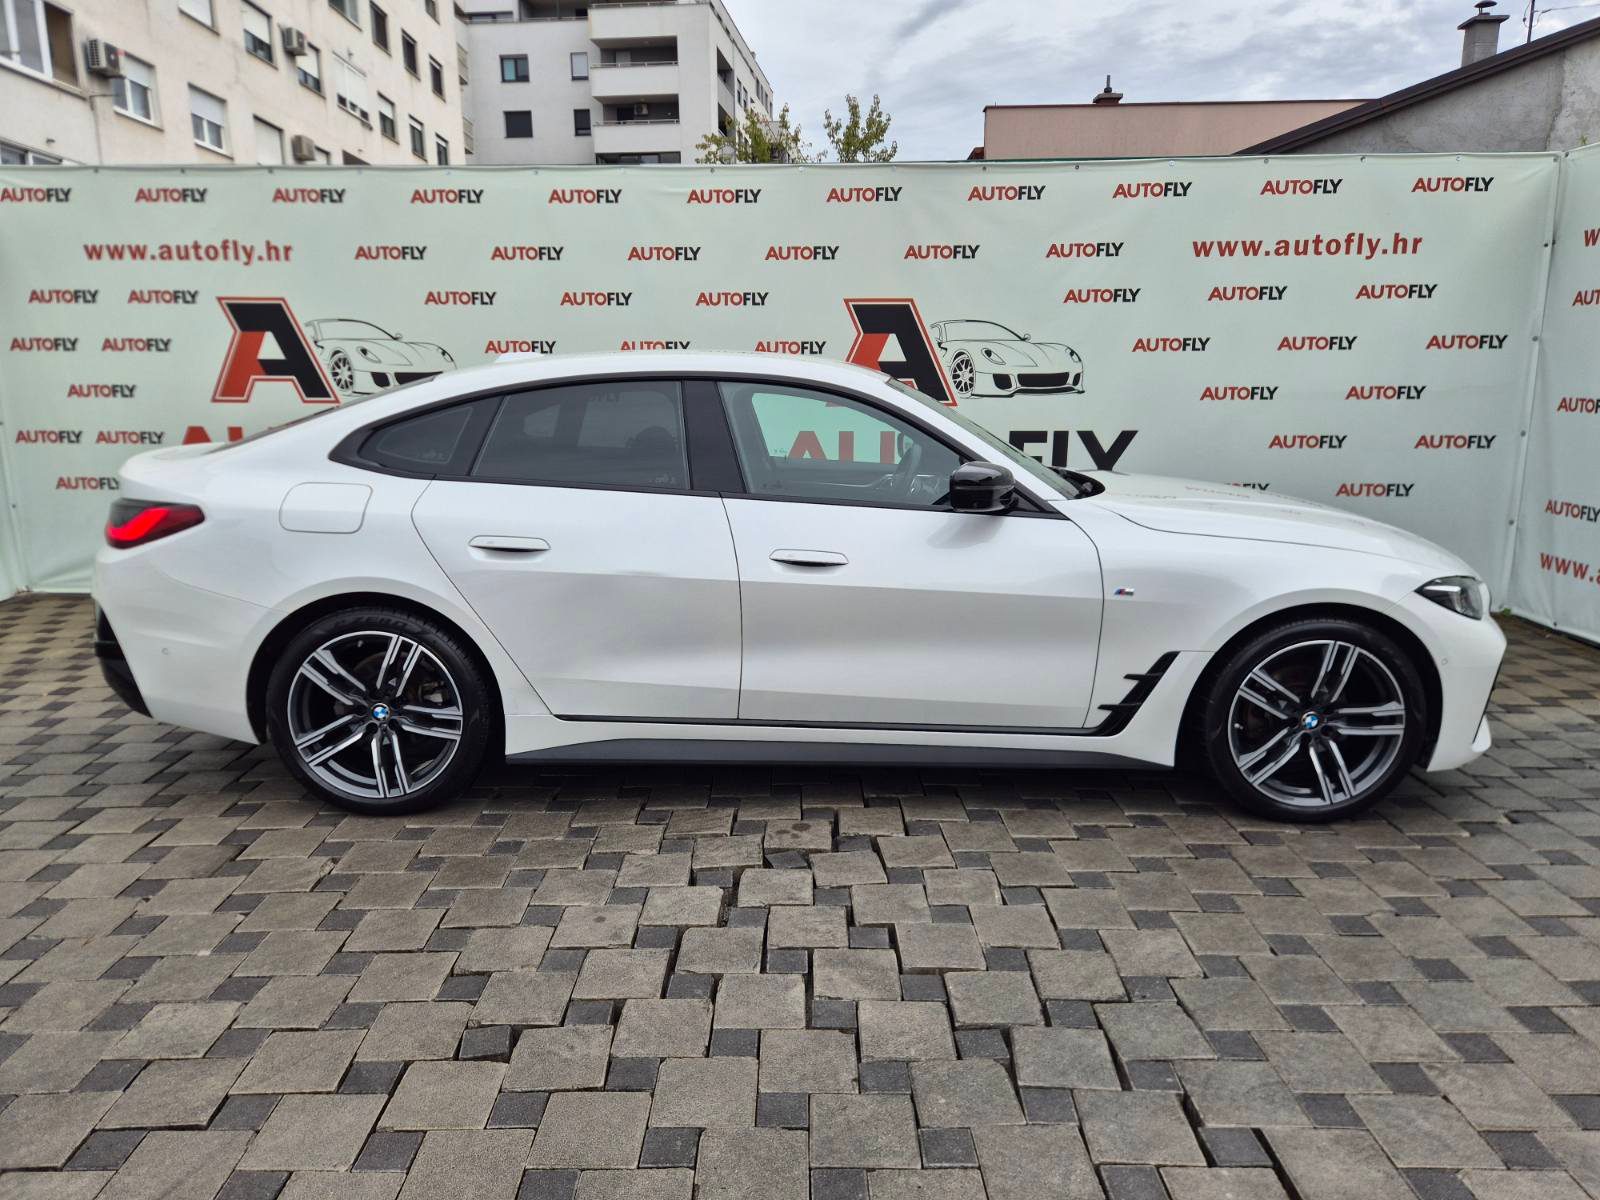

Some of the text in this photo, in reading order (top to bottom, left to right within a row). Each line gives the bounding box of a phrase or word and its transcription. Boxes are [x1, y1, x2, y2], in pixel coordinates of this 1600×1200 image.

[1113, 182, 1192, 198] AUTOFLY
[1260, 179, 1343, 195] AUTOFLY
[1411, 177, 1494, 192] AUTOFLY
[0, 188, 71, 202] AUTOFLY
[135, 188, 207, 203] AUTOFLY
[272, 188, 346, 203] AUTOFLY
[411, 189, 483, 203] AUTOFLY
[549, 189, 622, 203] AUTOFLY
[687, 189, 761, 204] AUTOFLY
[827, 187, 902, 202] AUTOFLY
[968, 186, 1046, 201] AUTOFLY
[84, 239, 292, 265] www.autofly.hr
[355, 246, 427, 260] AUTOFLY
[491, 247, 564, 260] AUTOFLY
[628, 247, 701, 260] AUTOFLY
[765, 246, 839, 260] AUTOFLY
[904, 245, 980, 259] AUTOFLY
[1046, 242, 1124, 258] AUTOFLY
[1193, 233, 1422, 260] www.autofly.hr
[29, 290, 98, 304] AUTOFLY
[128, 290, 198, 304] AUTOFLY
[425, 292, 496, 305] AUTOFLY
[1064, 288, 1141, 303] AUTOFLY
[1208, 286, 1287, 301] AUTOFLY
[1356, 284, 1437, 299] AUTOFLY
[560, 292, 632, 306] AUTOFLY
[696, 292, 768, 306] AUTOFLY
[10, 338, 78, 351] AUTOFLY
[102, 338, 171, 352] AUTOFLY
[485, 341, 556, 354] AUTOFLY
[755, 341, 826, 354] AUTOFLY
[1132, 337, 1210, 352] AUTOFLY
[1277, 336, 1357, 351] AUTOFLY
[1426, 335, 1508, 349] AUTOFLY
[68, 384, 136, 398] AUTOFLY
[1200, 387, 1278, 400] AUTOFLY
[1346, 386, 1426, 400] AUTOFLY
[16, 430, 82, 443] AUTOFLY
[96, 431, 164, 444] AUTOFLY
[1269, 435, 1347, 448] AUTOFLY
[1414, 435, 1496, 449] AUTOFLY
[1336, 484, 1414, 497] AUTOFLY
